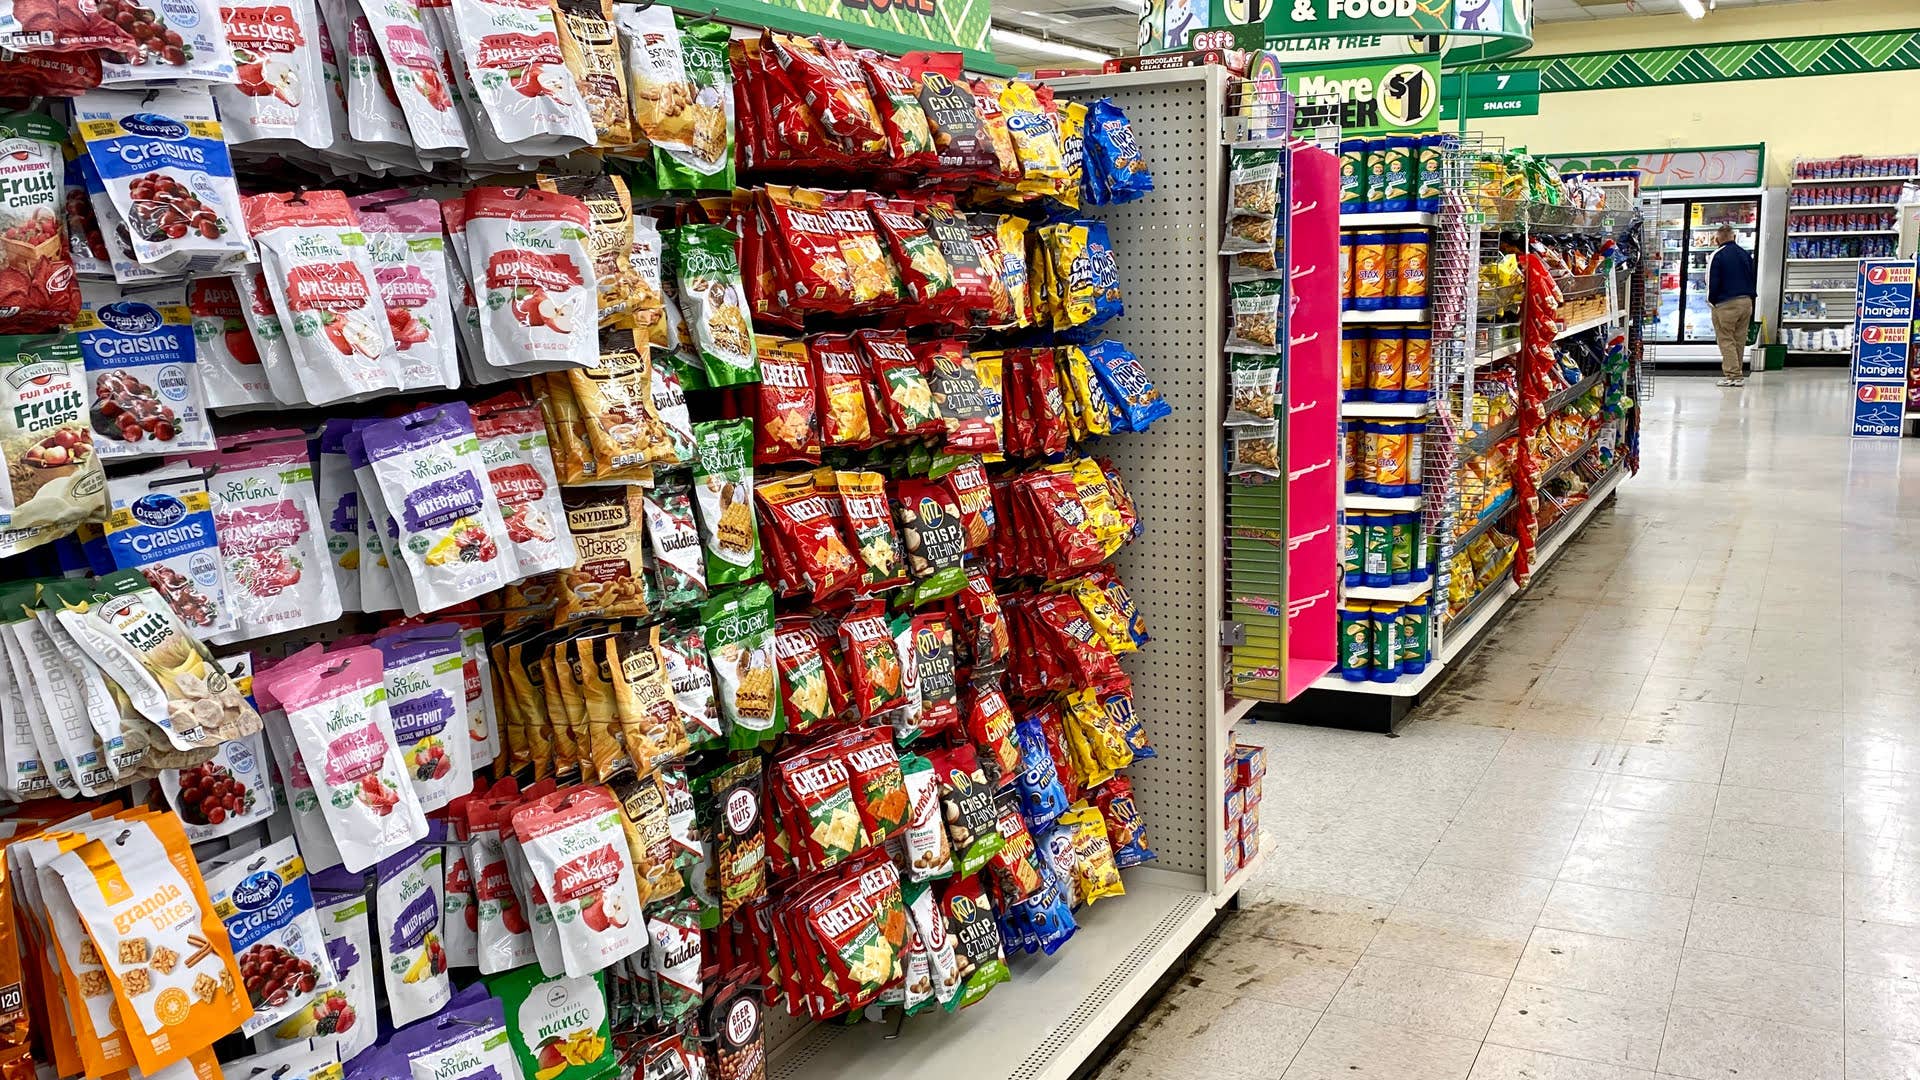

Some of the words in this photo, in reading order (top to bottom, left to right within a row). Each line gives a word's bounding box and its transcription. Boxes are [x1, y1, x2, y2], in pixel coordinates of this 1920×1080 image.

[1290, 0, 1317, 22] &
[1328, 0, 1417, 19] FOOD
[1194, 31, 1234, 50] Gift
[1337, 35, 1382, 50] TREE
[1140, 56, 1184, 65] CHOCOLATE
[1496, 75, 1511, 90] 7
[1300, 76, 1373, 106] More
[1384, 70, 1423, 122] $1
[1483, 100, 1522, 110] SNACKS
[1293, 98, 1379, 129] OWER
[120, 141, 205, 166] Craisins
[0, 161, 51, 175] TRAWBERRY
[9, 192, 54, 207] CRISPS
[936, 226, 968, 242] CRISP
[1873, 269, 1881, 280] 7
[1864, 305, 1910, 317] hangers
[1869, 328, 1876, 339] 7
[94, 333, 180, 358] Craisins
[103, 357, 127, 365] DRIED
[130, 352, 180, 363] CRANBERRIES
[1859, 364, 1904, 377] hangers
[19, 390, 41, 401] FUJI
[41, 382, 72, 396] APPLE
[1864, 387, 1871, 397] 7
[14, 389, 84, 428] Fruit
[29, 410, 78, 432] CRISPS
[1855, 423, 1899, 436] hangers
[219, 487, 278, 503] NATURAL
[227, 482, 243, 492] So
[136, 505, 162, 520] Ocean
[571, 505, 623, 525] SNYDER'S
[920, 501, 942, 525] RITZ
[132, 522, 203, 553] Craisins
[922, 525, 957, 546] CRISP
[142, 552, 161, 561] DRIED
[162, 540, 205, 556] CRANBERRIES
[576, 536, 626, 558] Pieces
[118, 610, 148, 630] BANANA
[138, 626, 174, 653] CRISPS
[917, 633, 941, 655] RITZ
[919, 661, 950, 678] CRISP
[387, 679, 432, 700] NATURAL
[393, 677, 407, 687] So
[415, 708, 443, 727] FRUIT
[729, 794, 748, 815] BEER
[960, 792, 988, 815] CRISP
[731, 805, 751, 827] NUTS
[112, 882, 182, 935] granola
[152, 899, 193, 932] bites
[229, 894, 294, 940] Craisins
[418, 905, 435, 927] FRUIT
[239, 932, 260, 946] DRIED
[959, 918, 991, 944] CRISP
[538, 1009, 590, 1038] mango
[731, 1004, 749, 1026] BEER
[734, 1016, 752, 1039] NUTS
[435, 1057, 481, 1080] NATURAL
